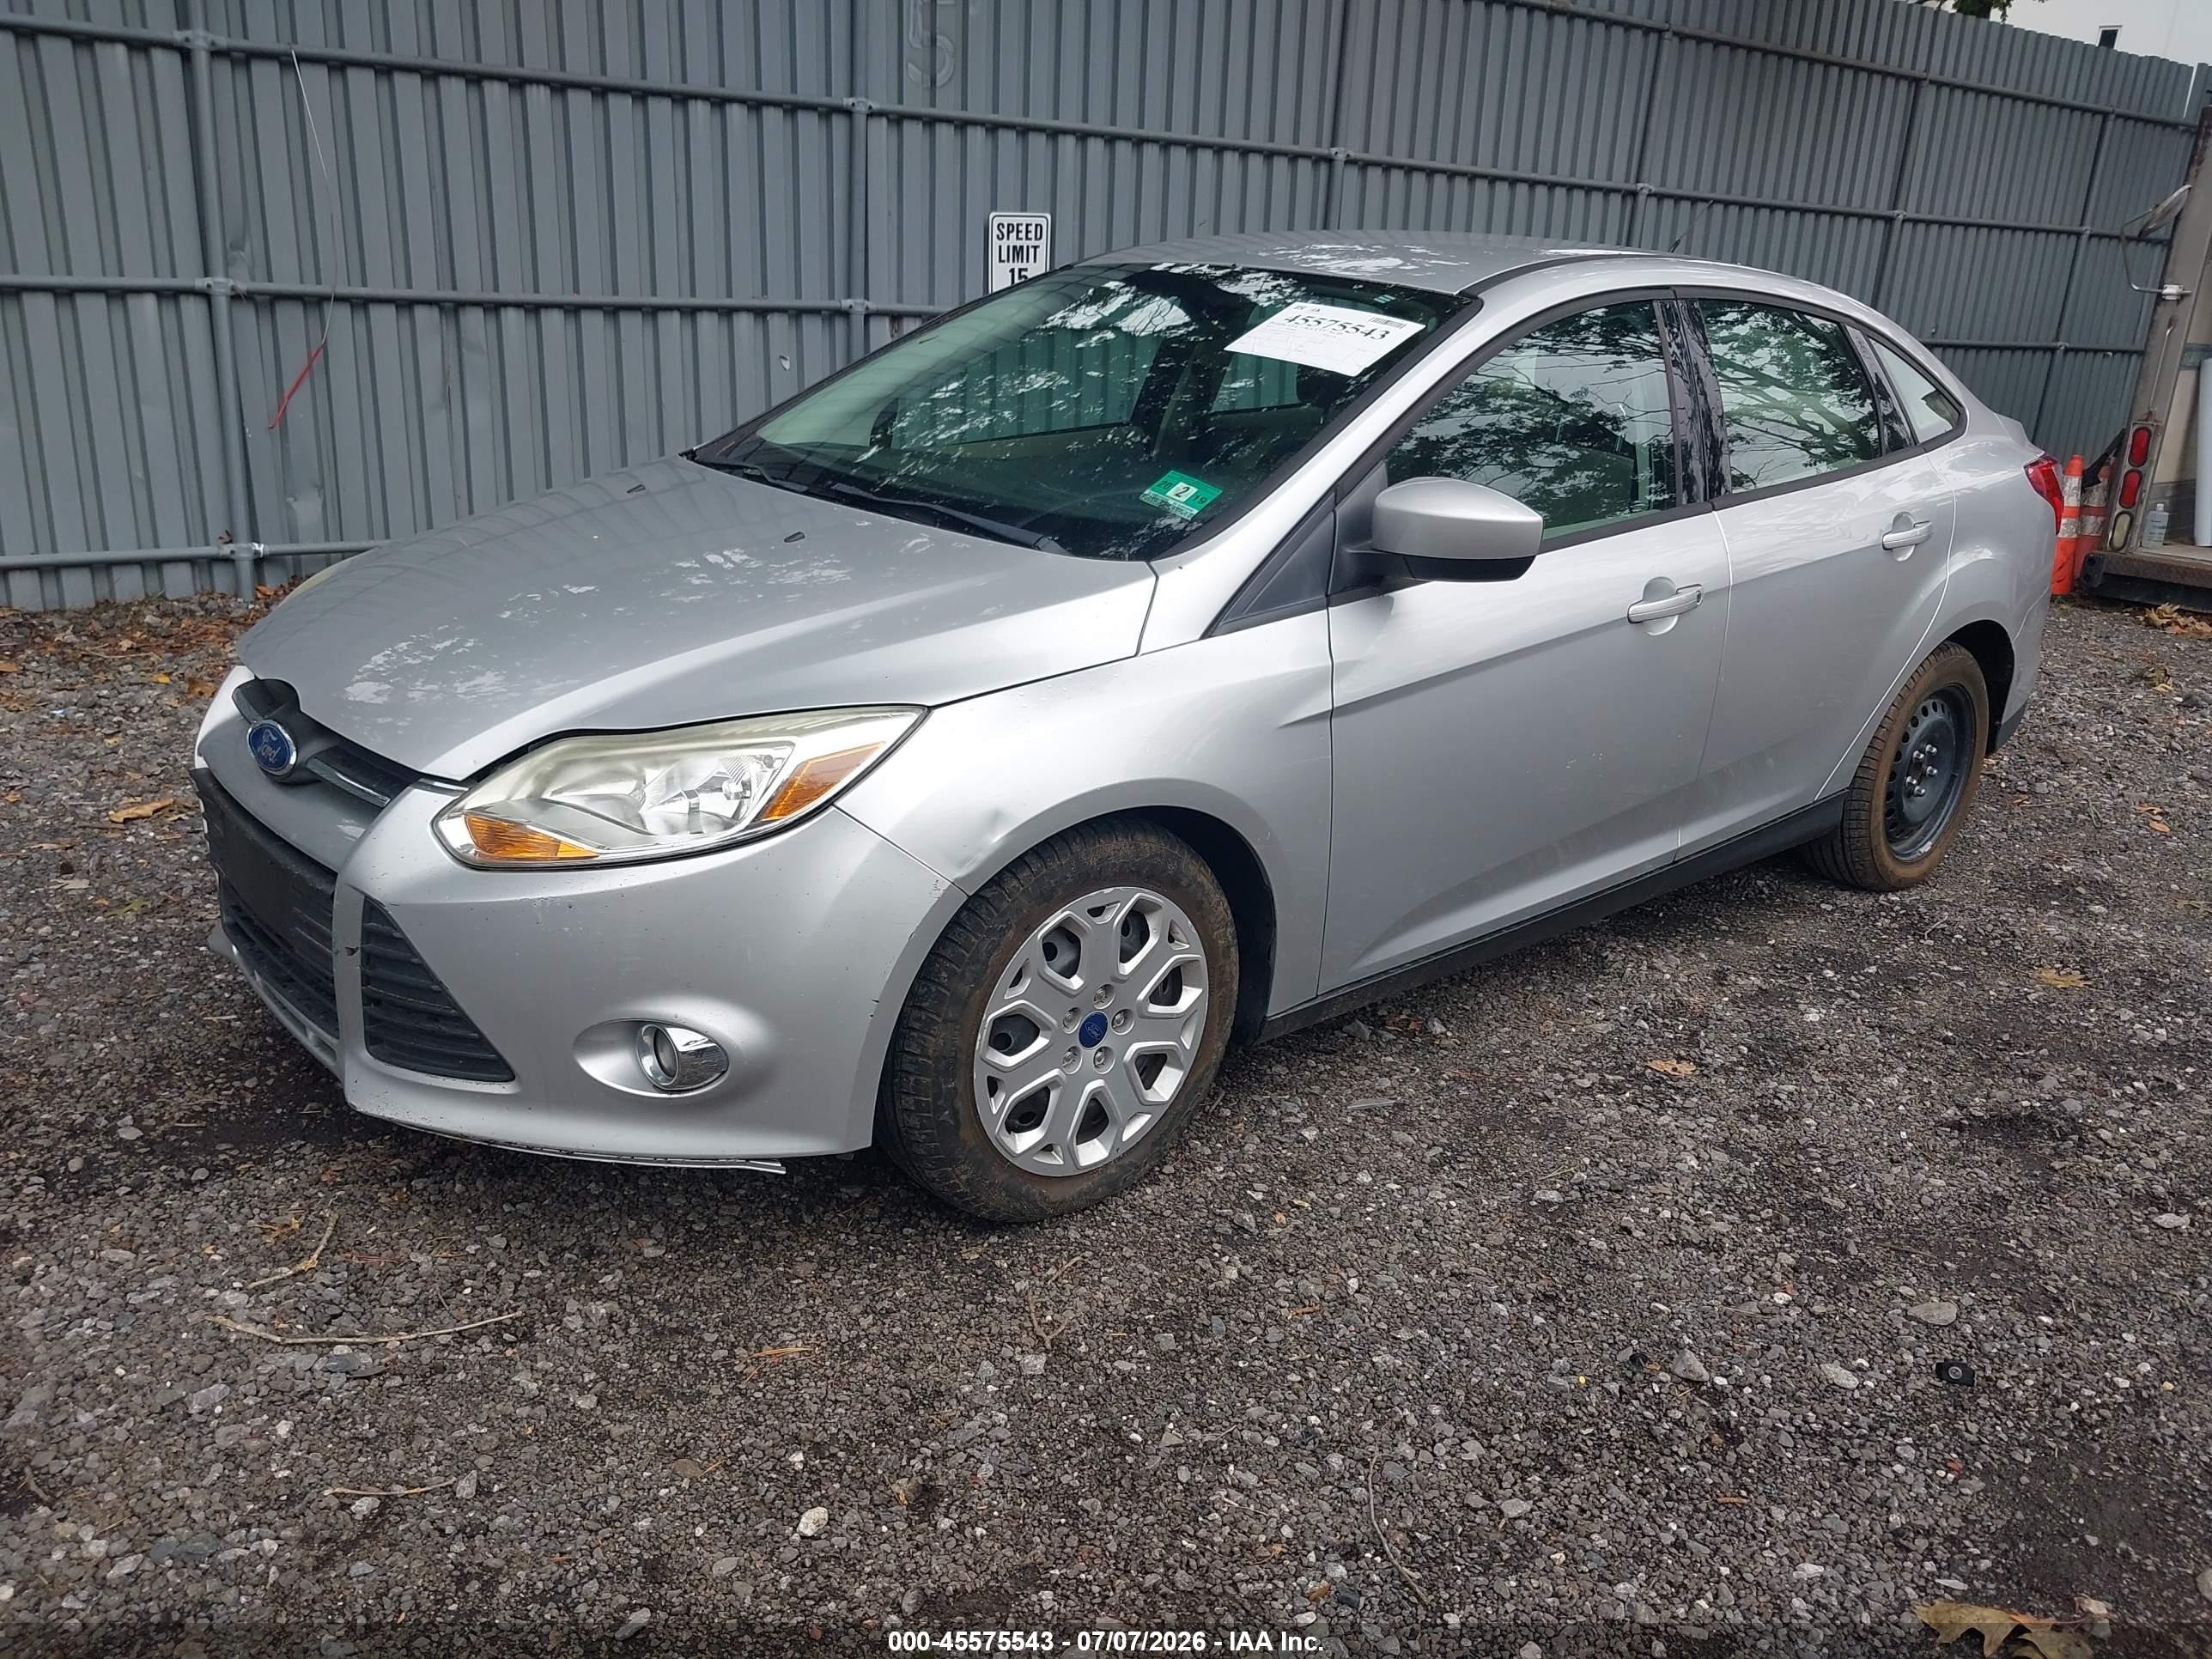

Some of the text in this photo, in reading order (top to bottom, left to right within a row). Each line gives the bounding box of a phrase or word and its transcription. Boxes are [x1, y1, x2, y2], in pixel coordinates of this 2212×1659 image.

[996, 223, 1043, 241] SPEED
[998, 245, 1041, 264] LIMIT
[1284, 314, 1390, 340] 45575543
[1175, 487, 1190, 497] 2
[1193, 495, 1207, 504] 19
[257, 728, 282, 763] Ford
